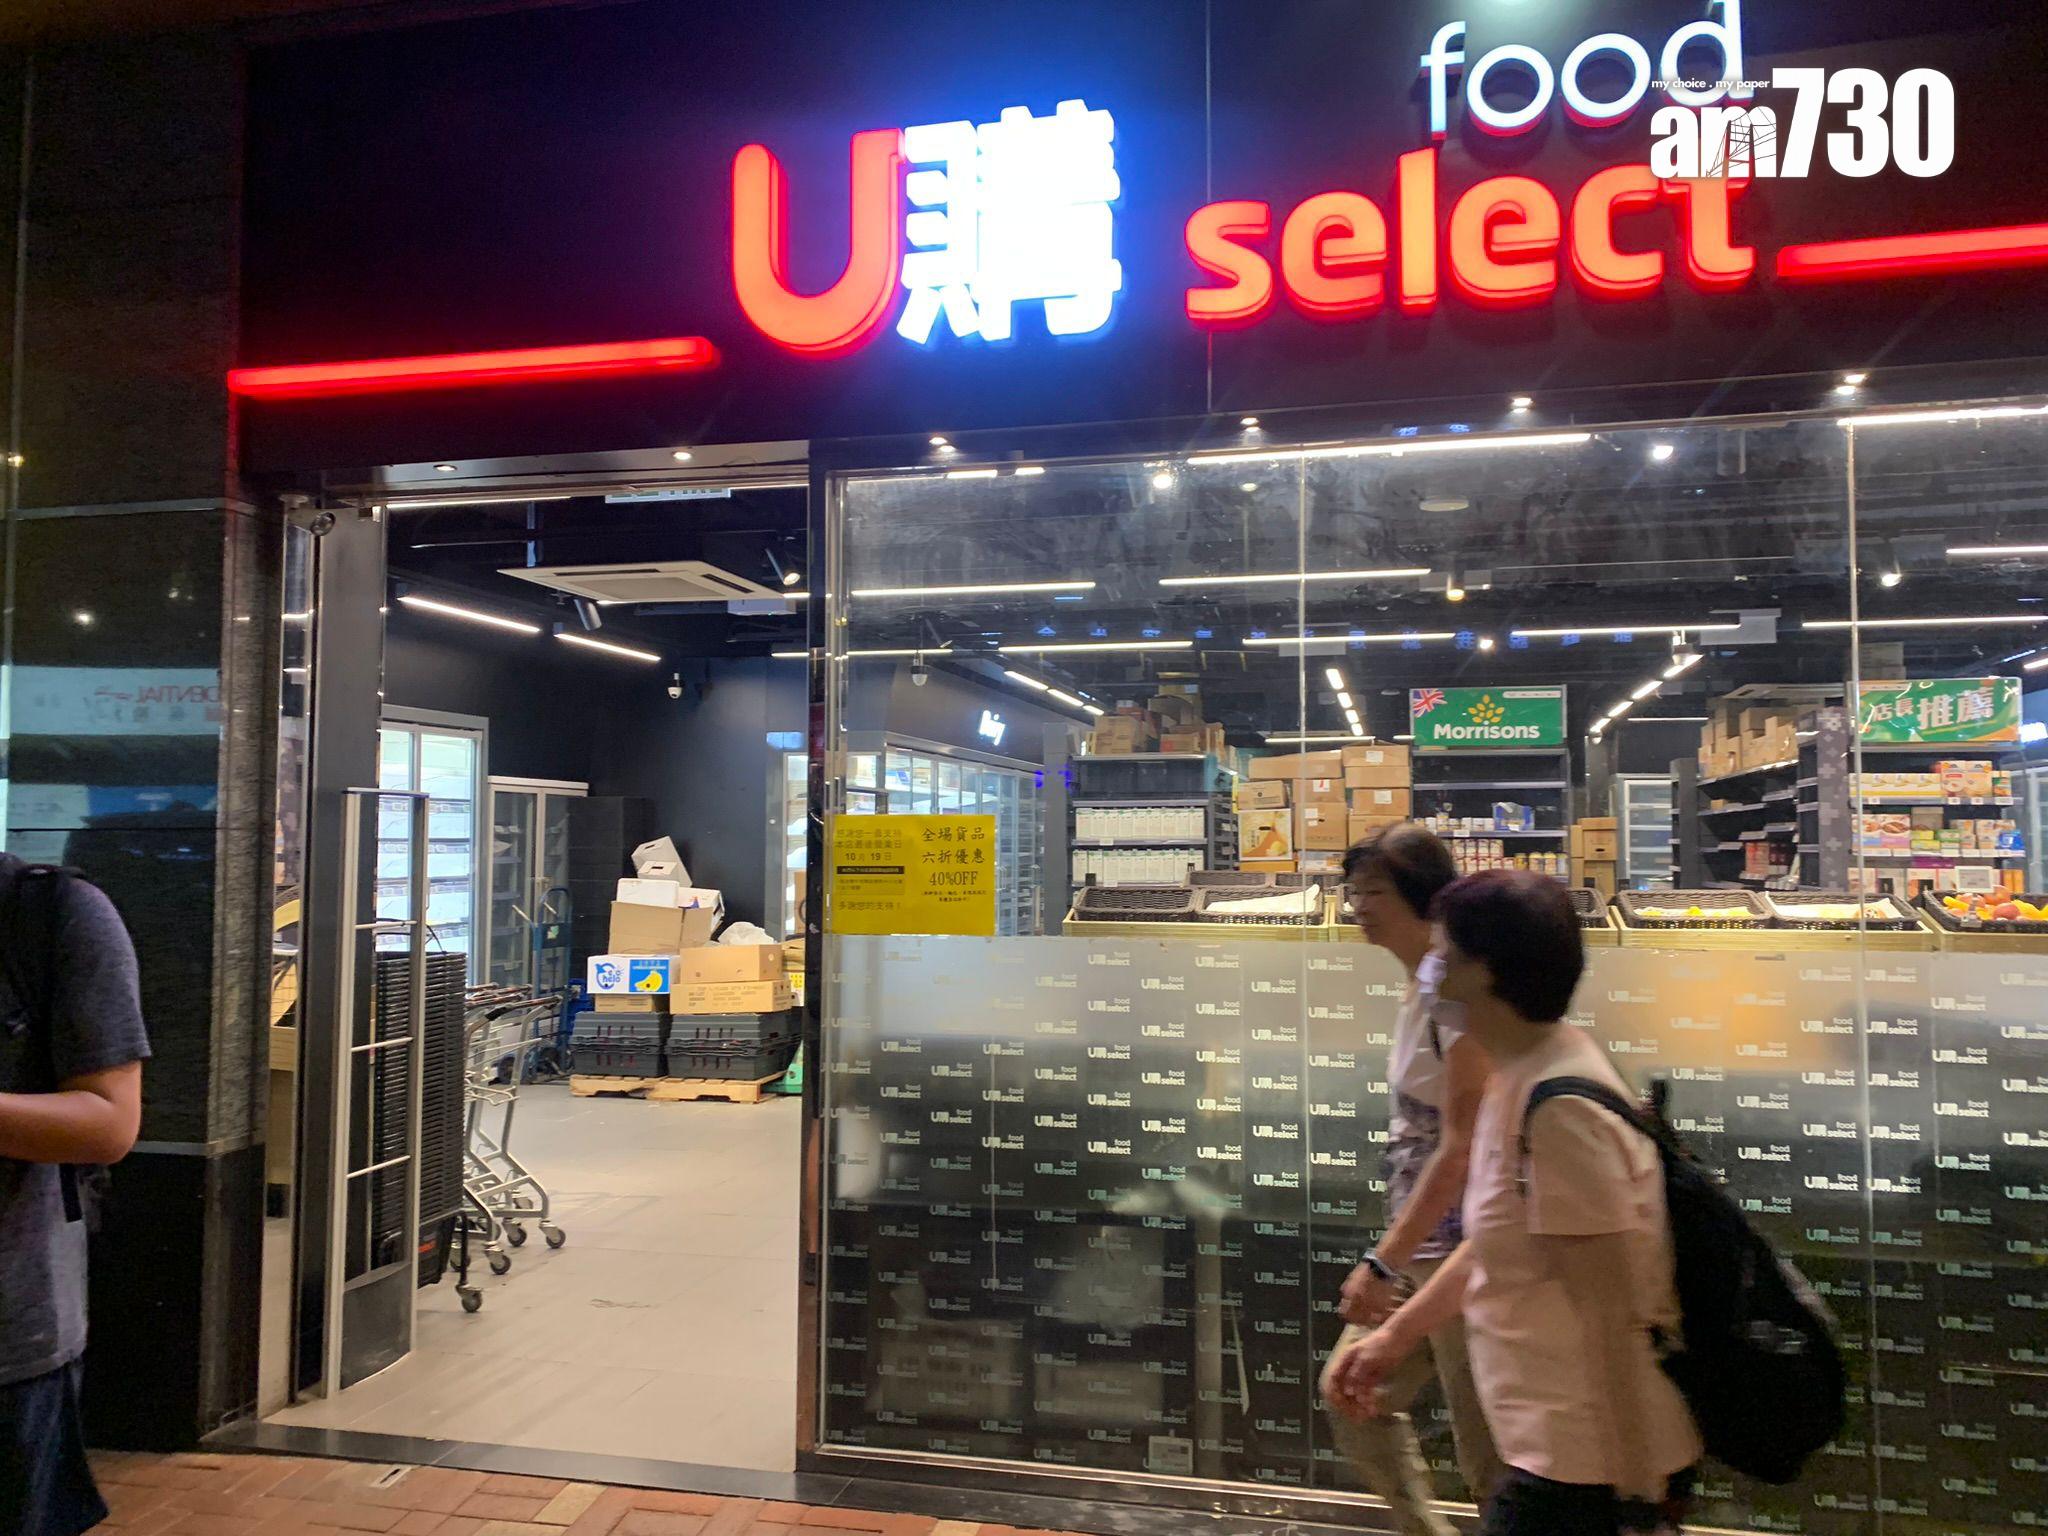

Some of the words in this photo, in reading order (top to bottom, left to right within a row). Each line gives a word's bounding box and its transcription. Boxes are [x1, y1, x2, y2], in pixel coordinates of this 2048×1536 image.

[1420, 0, 1753, 133] food
[1185, 149, 1755, 321] select
[1434, 721, 1540, 739] Morrisons
[923, 826, 985, 842] 全場貨品
[922, 848, 985, 865] 六折優惠
